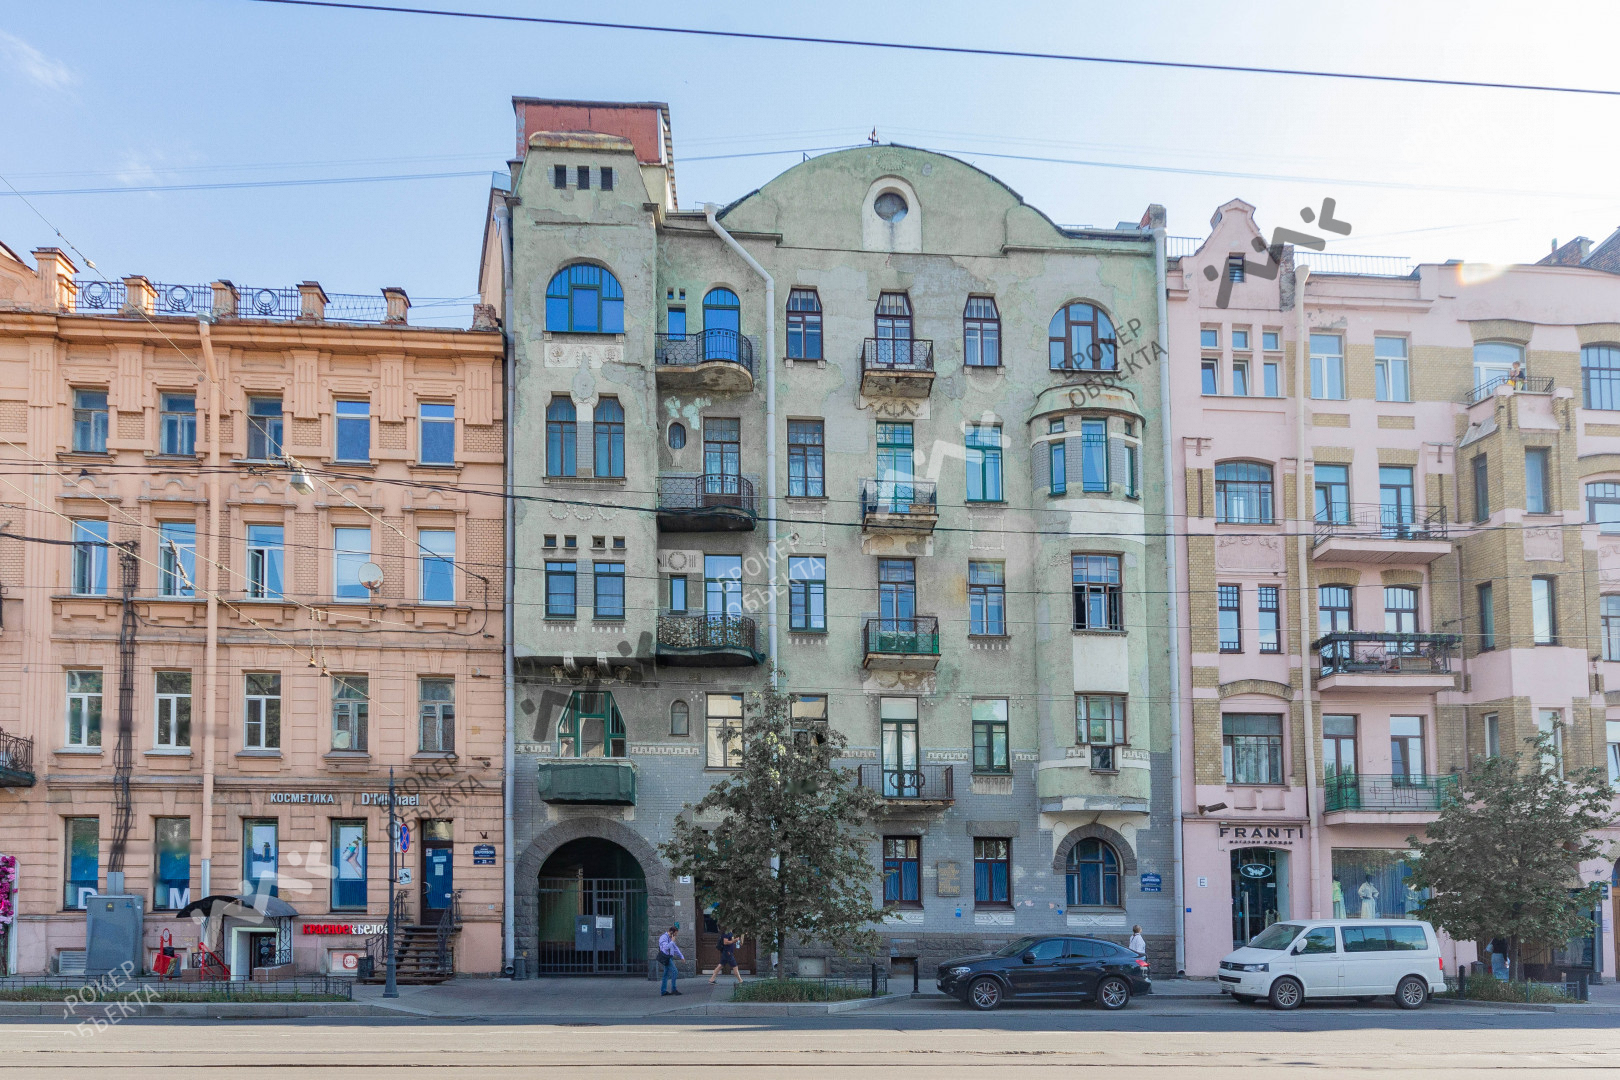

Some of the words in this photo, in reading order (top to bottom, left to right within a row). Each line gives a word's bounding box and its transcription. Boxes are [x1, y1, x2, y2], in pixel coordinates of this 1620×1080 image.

[270, 792, 335, 804] КОСМЕТИКА
[361, 792, 419, 806] D'Mihael
[1219, 827, 1303, 839] FRANTI
